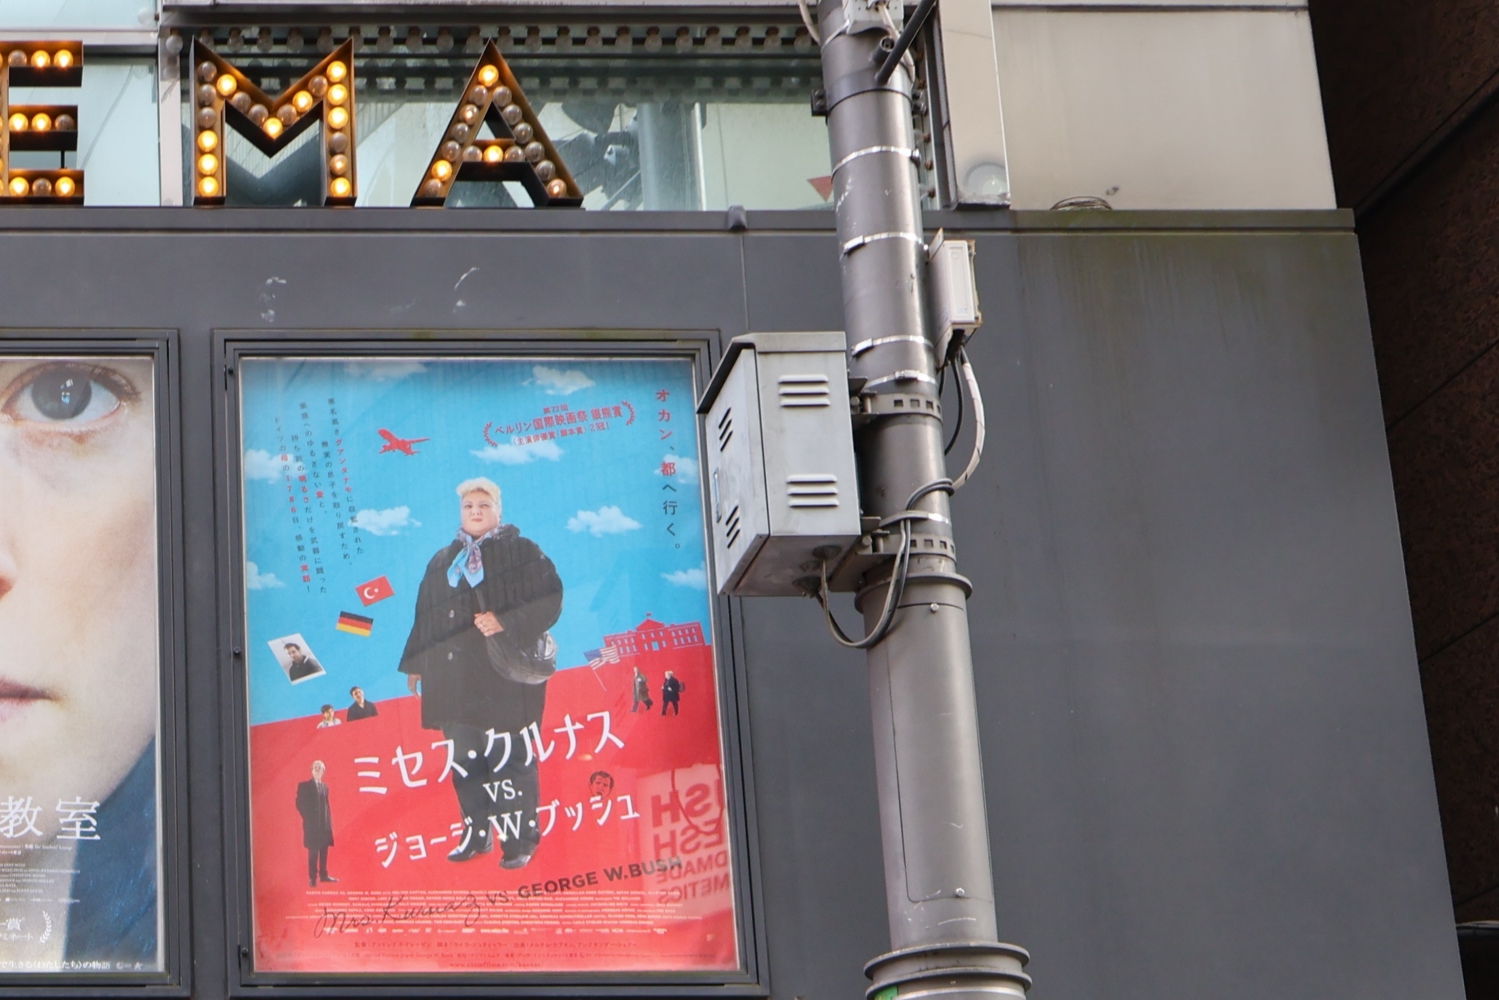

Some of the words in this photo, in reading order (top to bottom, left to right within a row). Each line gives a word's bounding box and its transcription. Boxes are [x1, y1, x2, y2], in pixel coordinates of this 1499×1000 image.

[495, 410, 588, 435] ベルリン国際映画祭
[656, 389, 680, 549] オカン、都へ行く。
[353, 710, 625, 795] ミセス・クルナス
[375, 794, 641, 869] ジョージ・W・ブッシュ
[517, 871, 599, 901] GEORGE
